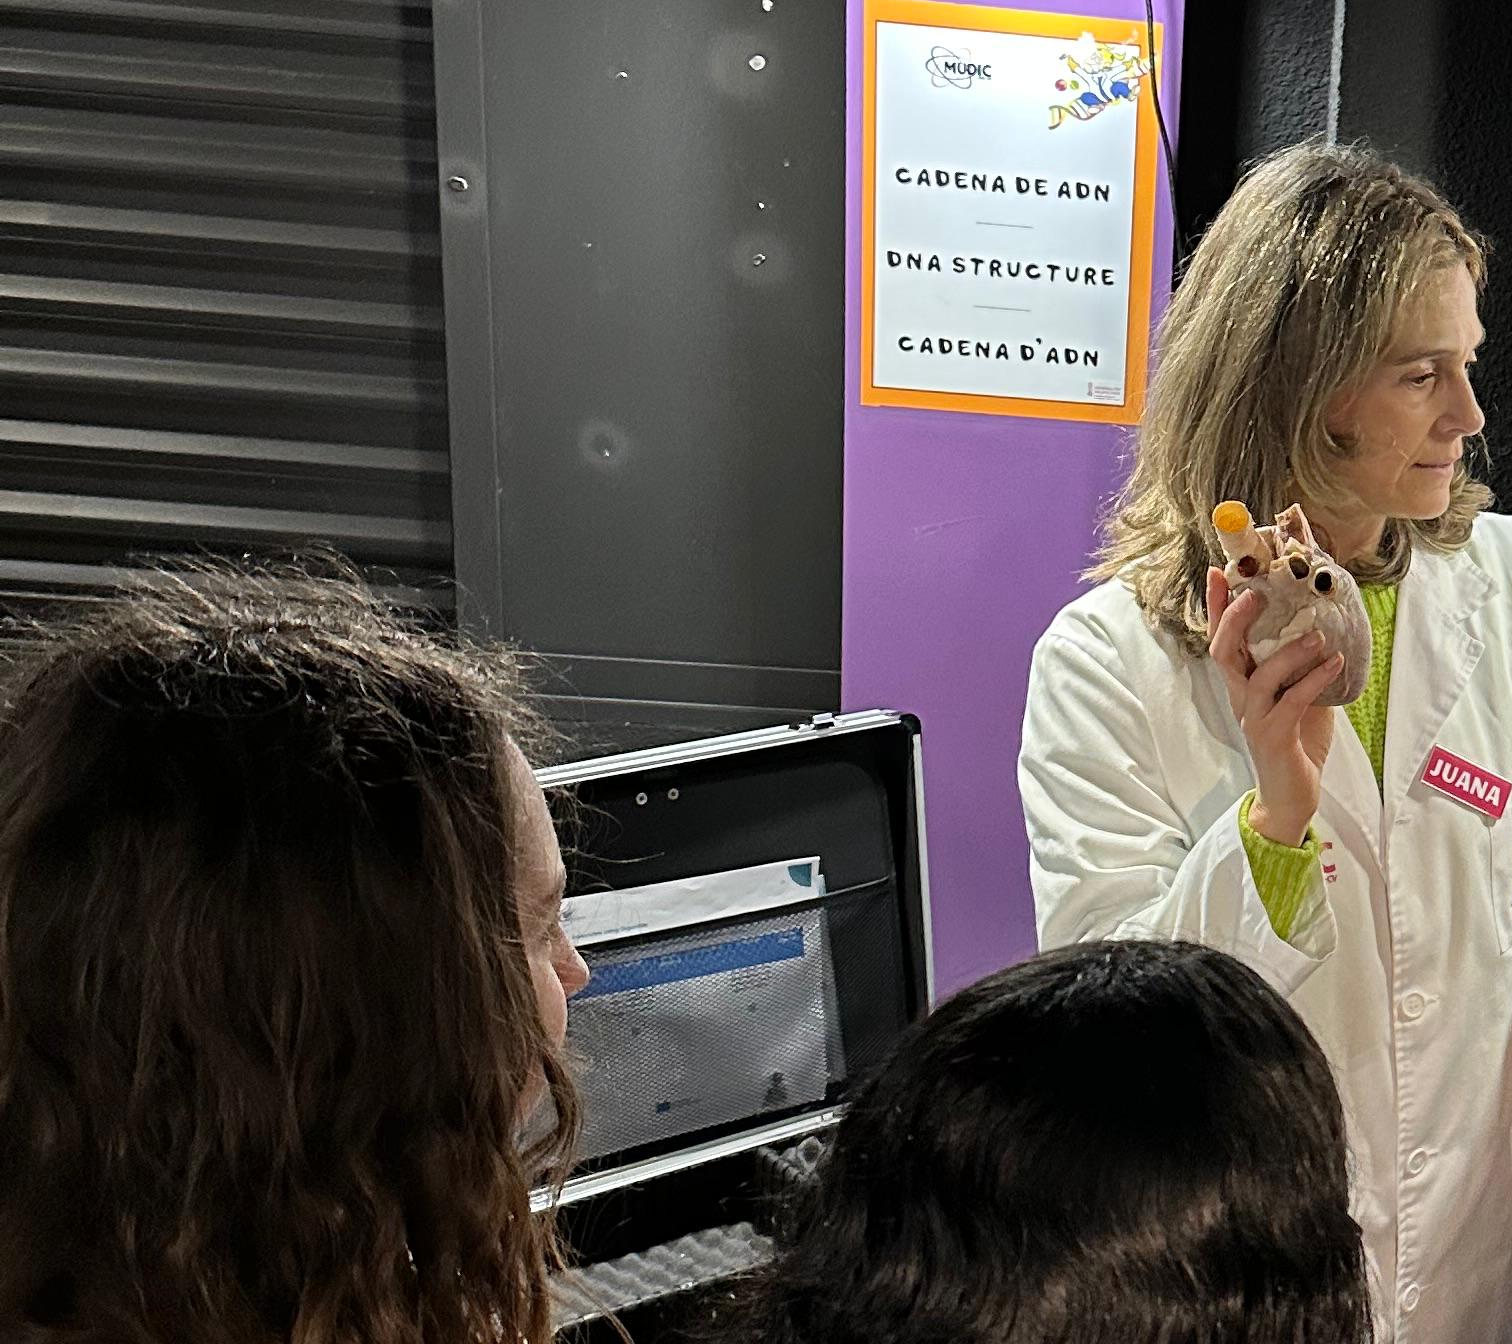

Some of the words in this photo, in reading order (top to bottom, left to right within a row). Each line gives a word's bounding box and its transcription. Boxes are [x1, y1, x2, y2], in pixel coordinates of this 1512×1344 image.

[944, 61, 992, 78] MUDIC
[895, 168, 1006, 194] CADENA
[1015, 176, 1048, 196] DE
[1057, 181, 1111, 203] ADN
[886, 250, 941, 272] DNA
[952, 256, 1115, 286] STRUCTURE
[898, 336, 1009, 361] CADENA
[1020, 337, 1099, 368] D'ADN
[1429, 758, 1501, 807] JUANA
